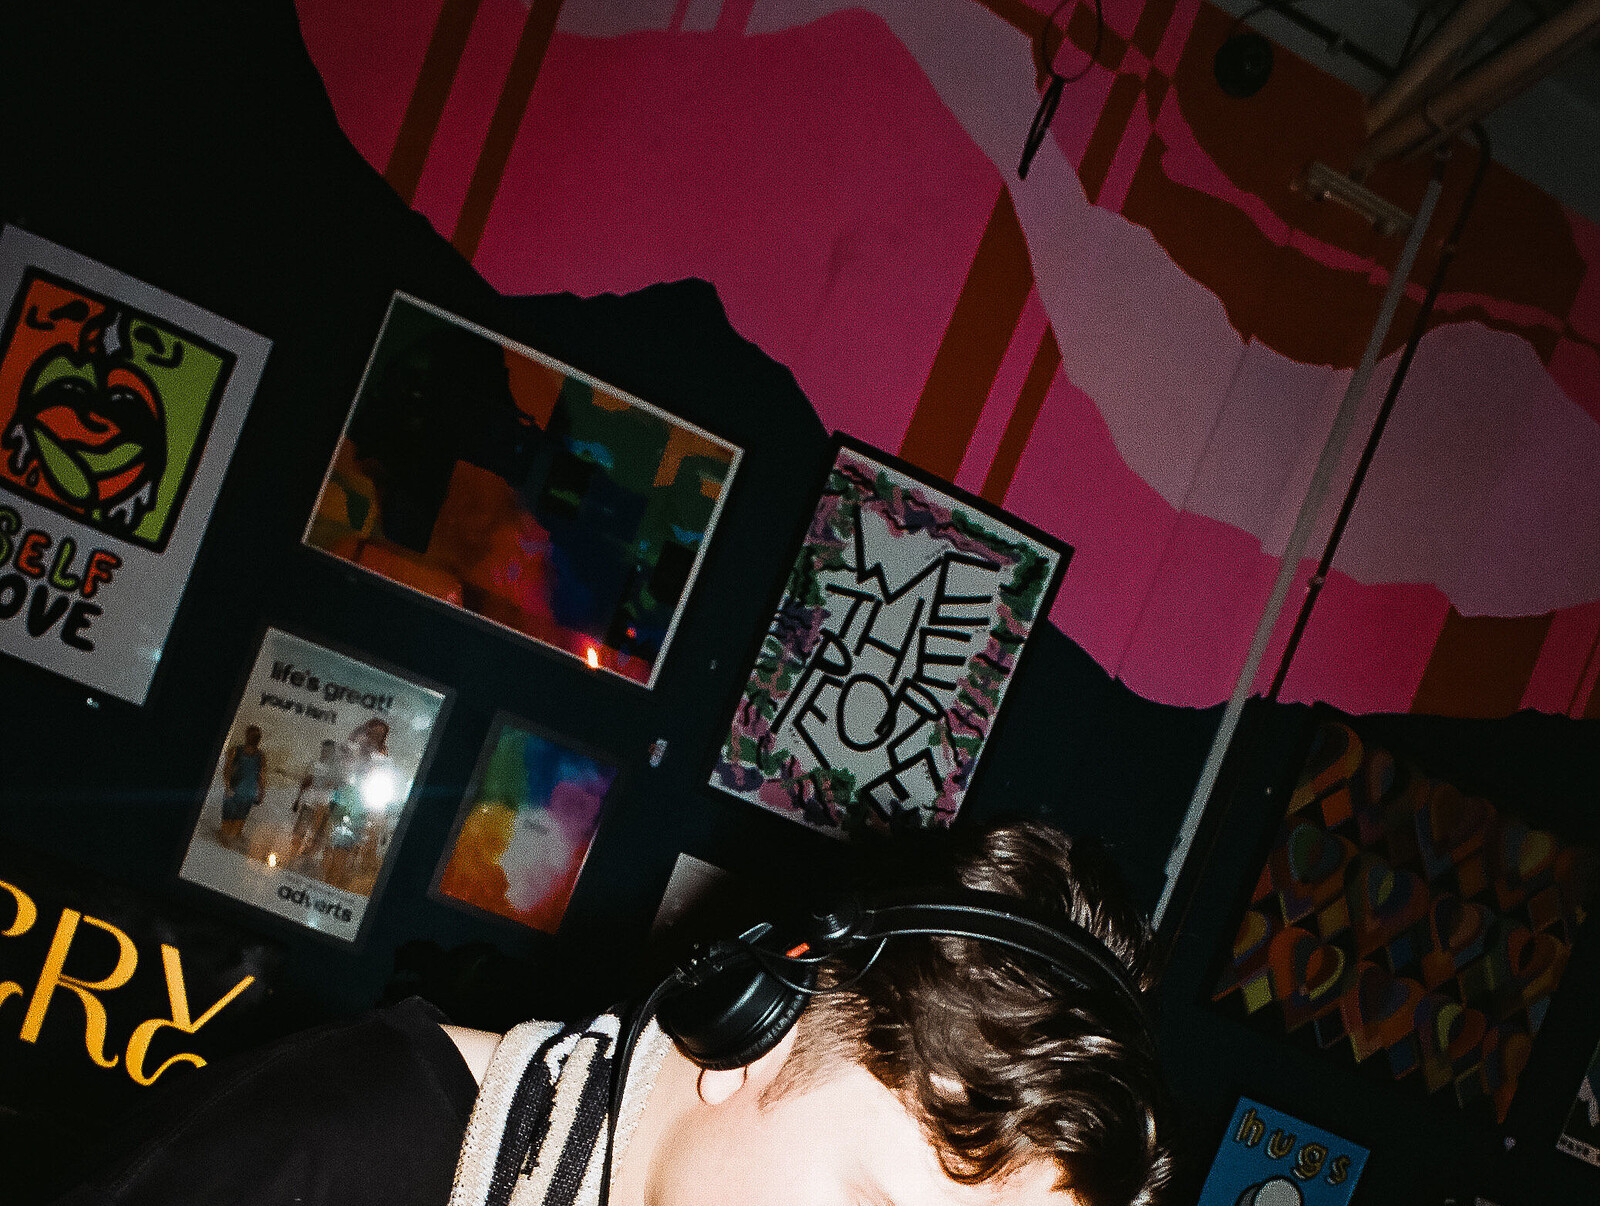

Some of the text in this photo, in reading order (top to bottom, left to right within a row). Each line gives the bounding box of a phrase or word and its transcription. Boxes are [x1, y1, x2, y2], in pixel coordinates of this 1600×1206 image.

[853, 503, 1000, 627] WE
[826, 583, 972, 690] THE
[1236, 1108, 1352, 1184] hugs
